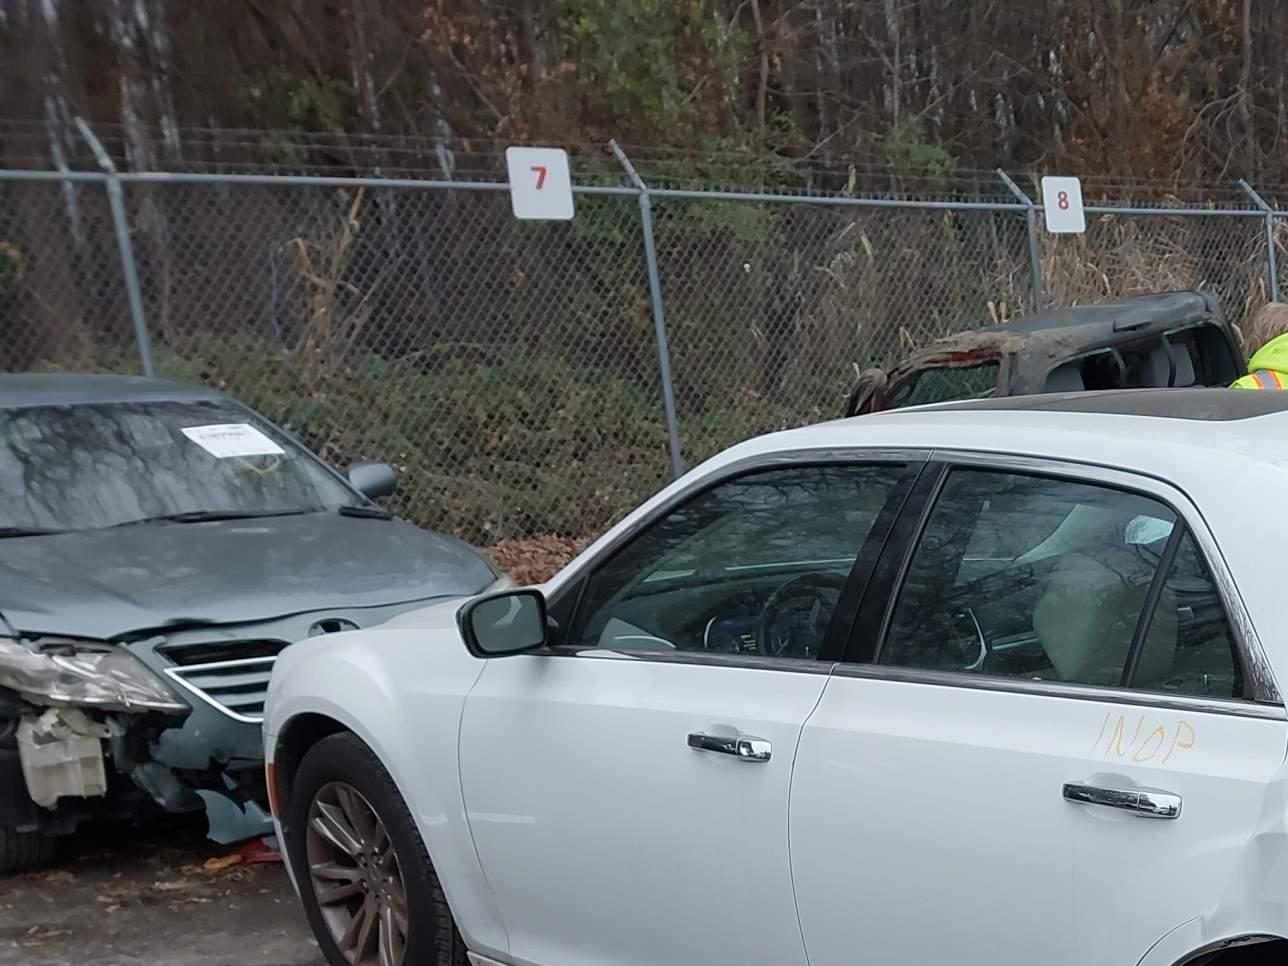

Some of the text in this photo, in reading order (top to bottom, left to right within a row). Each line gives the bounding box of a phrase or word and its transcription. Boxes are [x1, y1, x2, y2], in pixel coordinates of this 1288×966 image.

[530, 166, 547, 190] 7
[1057, 191, 1069, 210] 8
[1089, 711, 1197, 765] INOP
